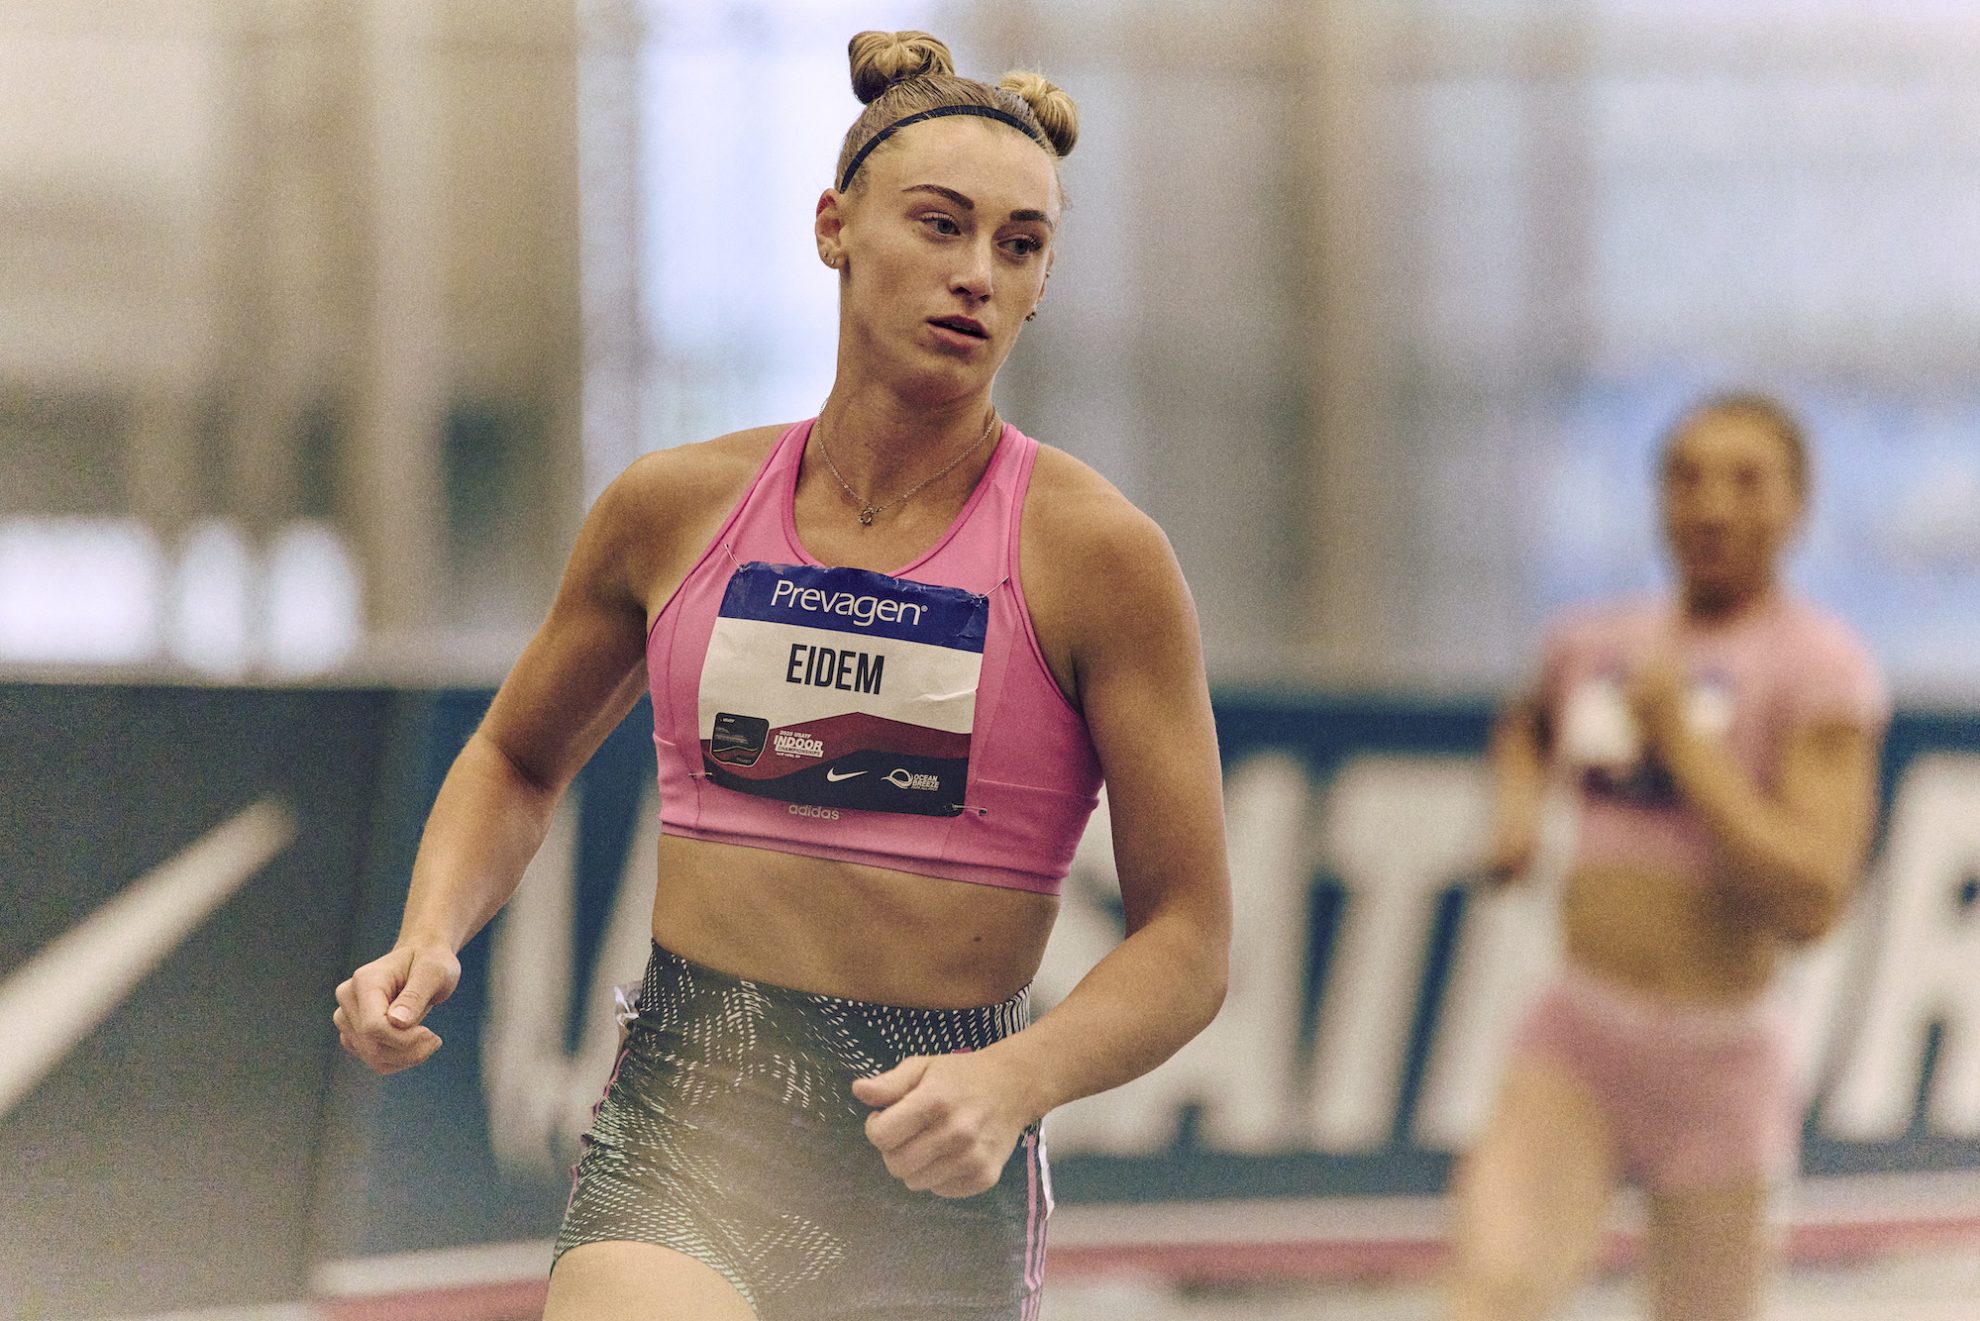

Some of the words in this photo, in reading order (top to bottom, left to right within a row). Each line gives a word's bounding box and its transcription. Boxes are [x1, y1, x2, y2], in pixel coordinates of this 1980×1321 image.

[786, 643, 885, 695] EIDEM
[773, 735, 824, 752] INDOOR
[913, 773, 939, 782] OCEAN
[788, 803, 840, 820] adidas
